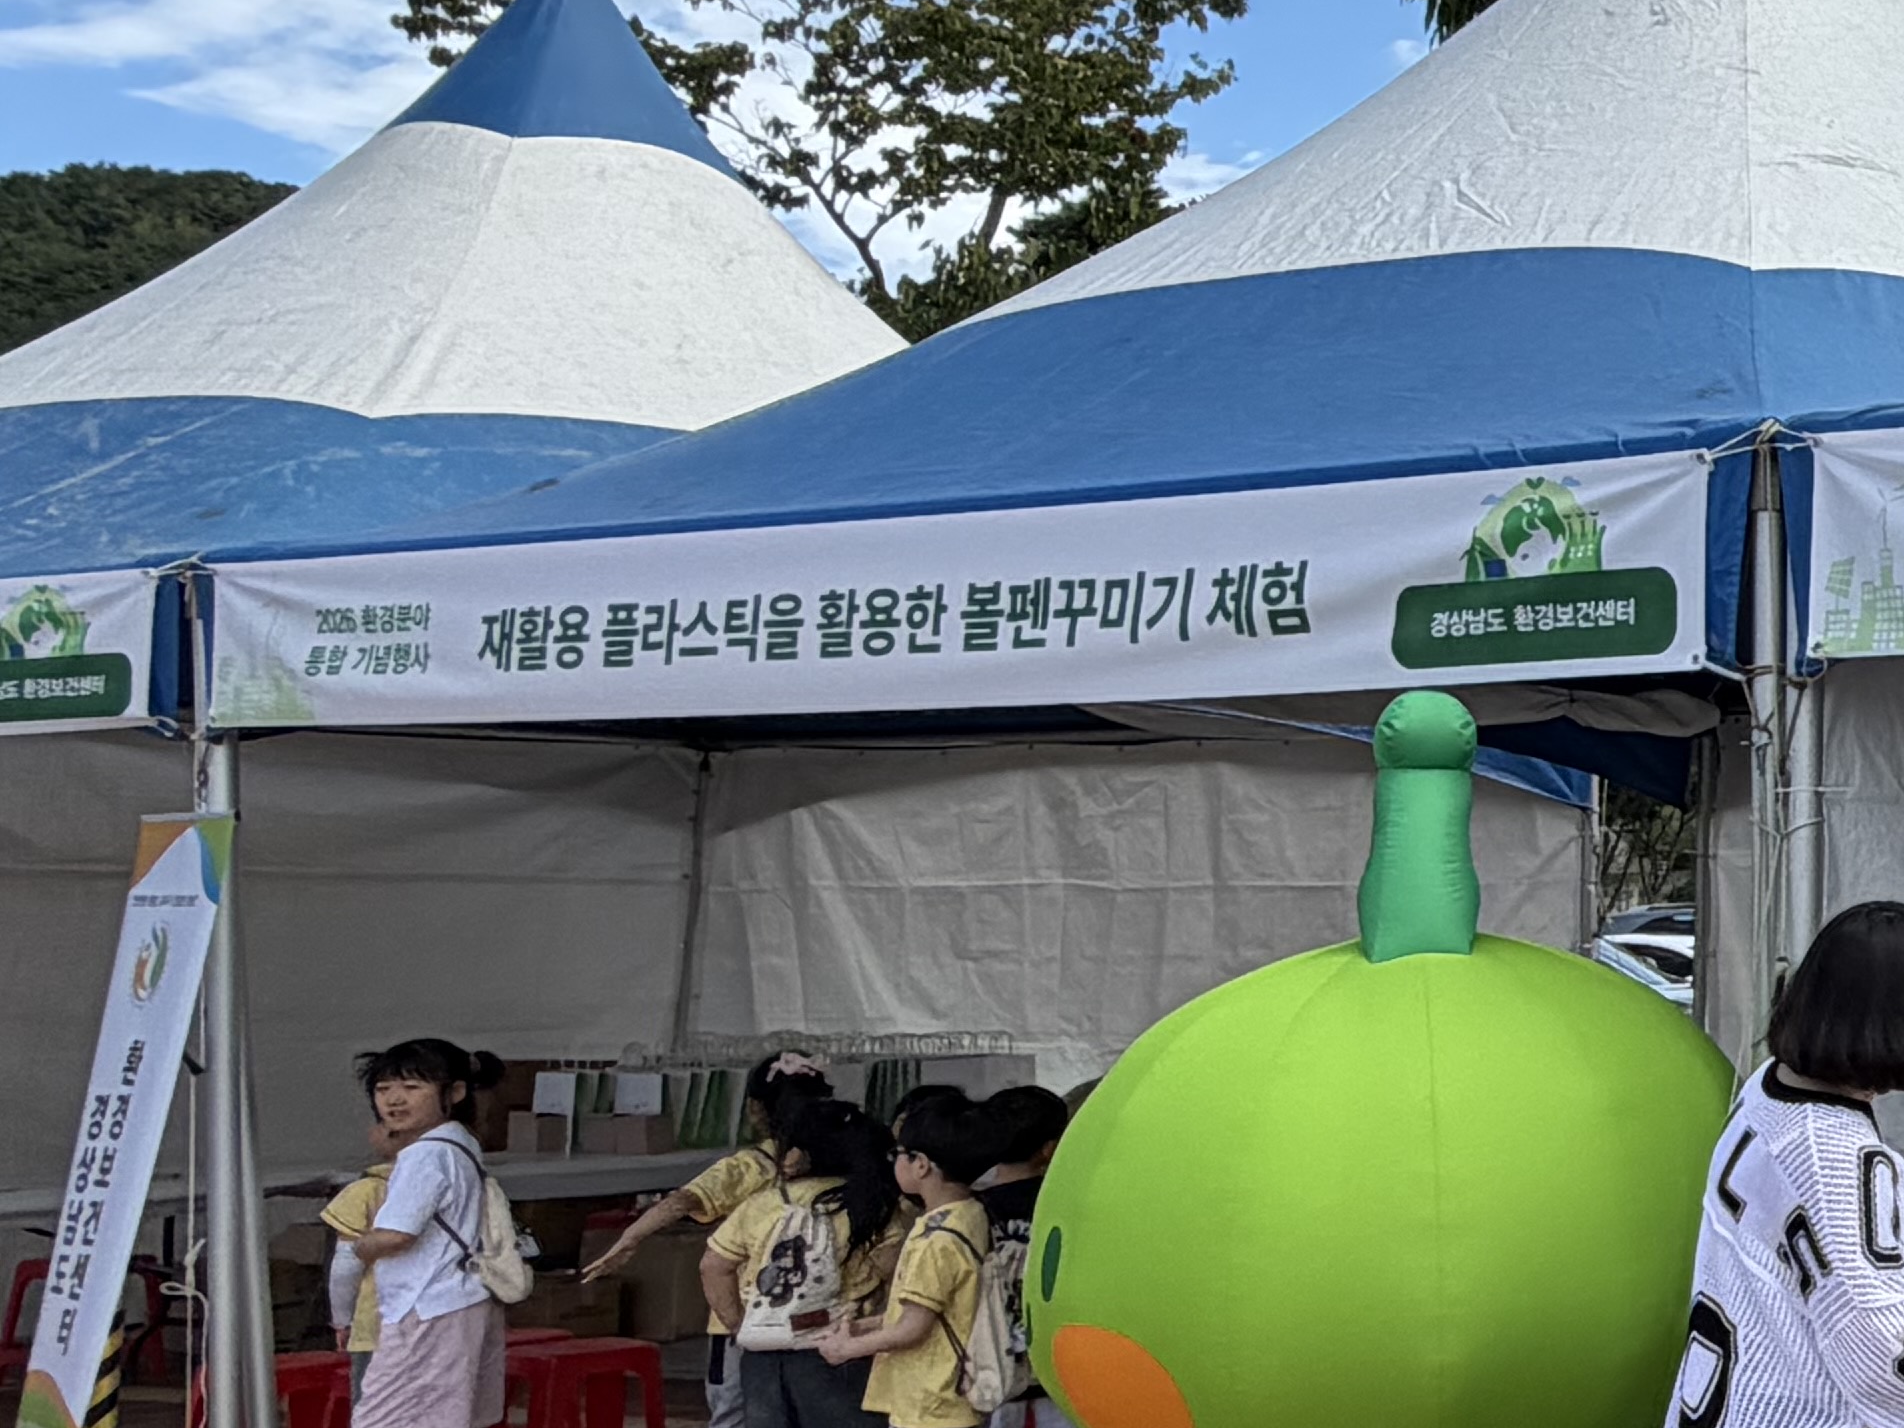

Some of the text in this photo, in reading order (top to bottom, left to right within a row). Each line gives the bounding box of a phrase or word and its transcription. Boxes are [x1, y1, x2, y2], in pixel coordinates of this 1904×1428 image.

[315, 603, 431, 634] 2026 환경분야
[478, 561, 1311, 672] 재활용 플라스틱을 활용한 볼펜꾸미기 체험
[1430, 598, 1635, 638] 경상남도 환경보건센터
[304, 642, 431, 677] 통합 기념행사
